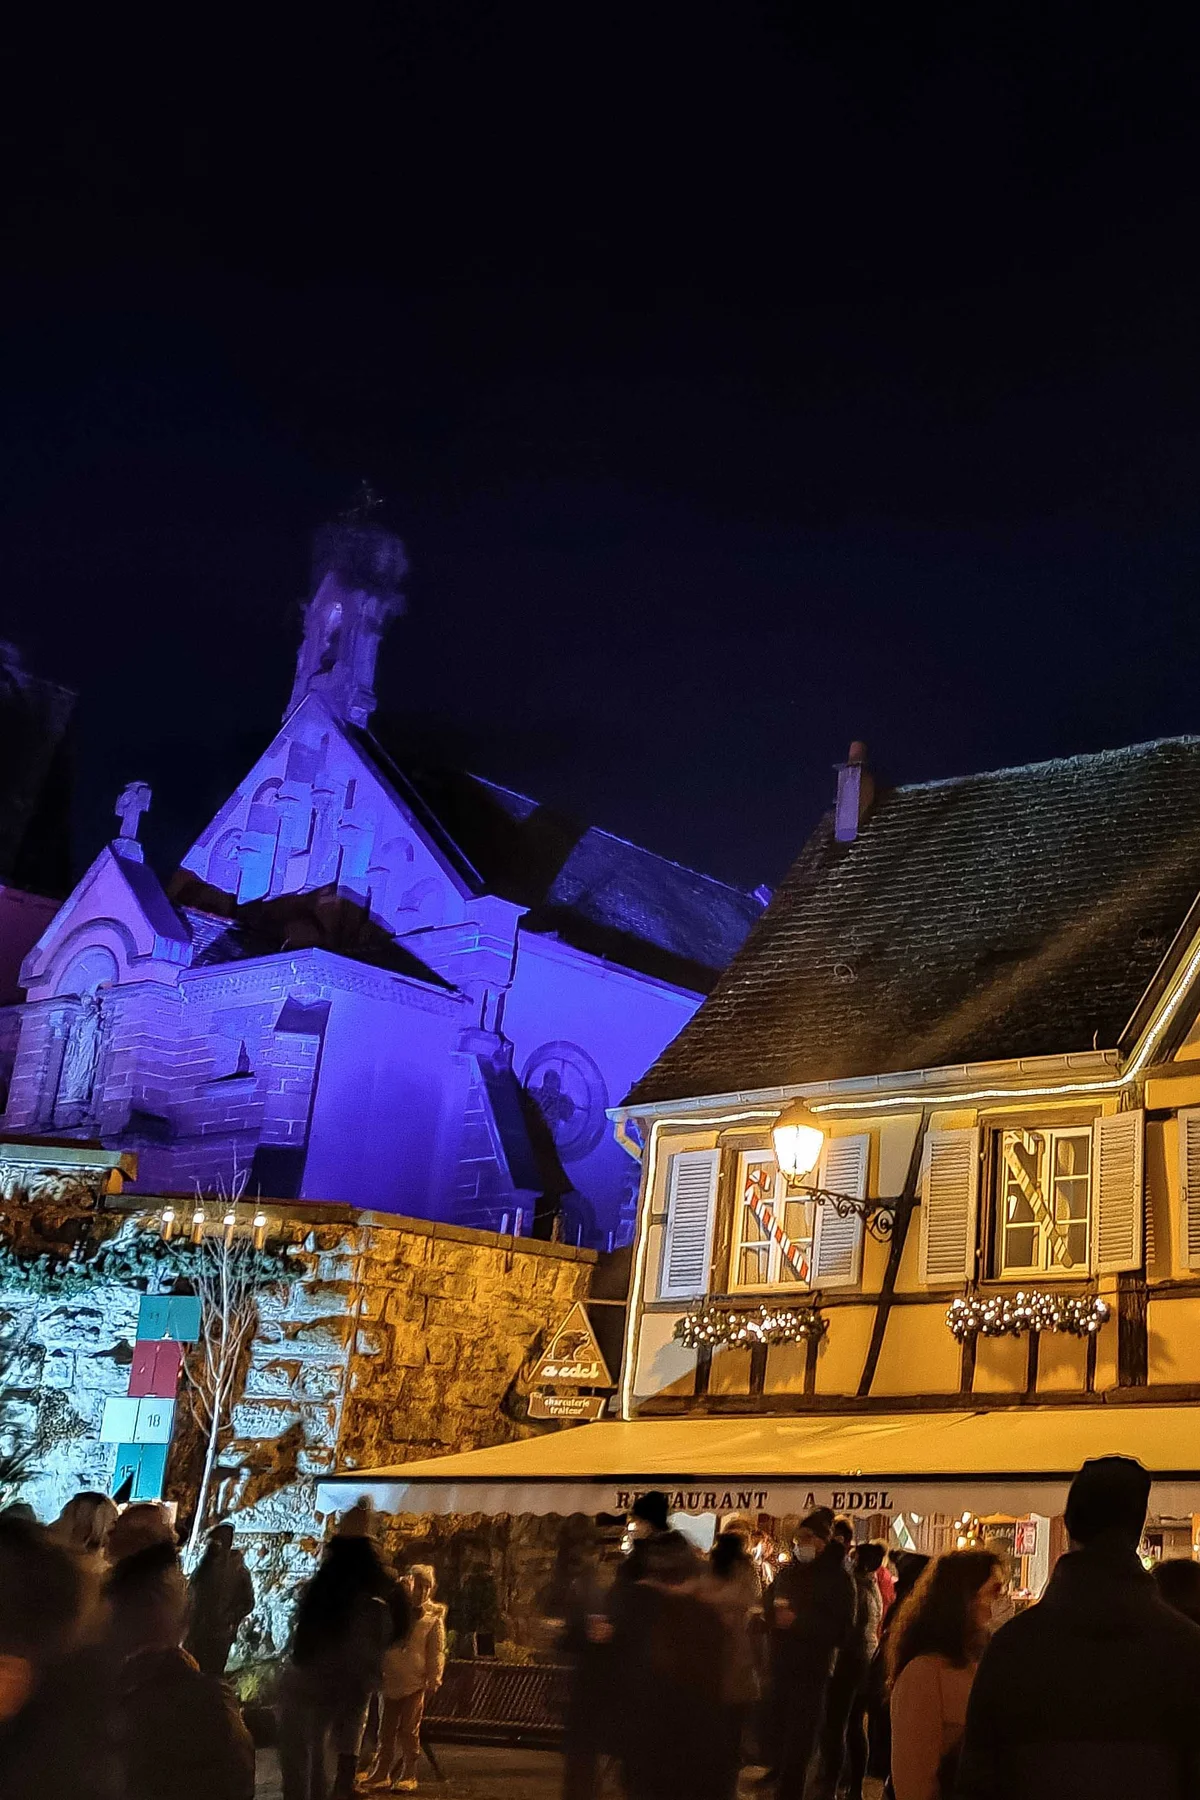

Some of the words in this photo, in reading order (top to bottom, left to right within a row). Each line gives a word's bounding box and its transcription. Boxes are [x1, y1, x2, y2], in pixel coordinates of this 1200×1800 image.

[544, 1398, 590, 1408] charcuterie
[550, 1407, 584, 1415] traiteur
[147, 1414, 160, 1428] 18
[615, 1491, 767, 1509] RTAURANT
[803, 1492, 816, 1509] A
[832, 1491, 893, 1509] EDEL
